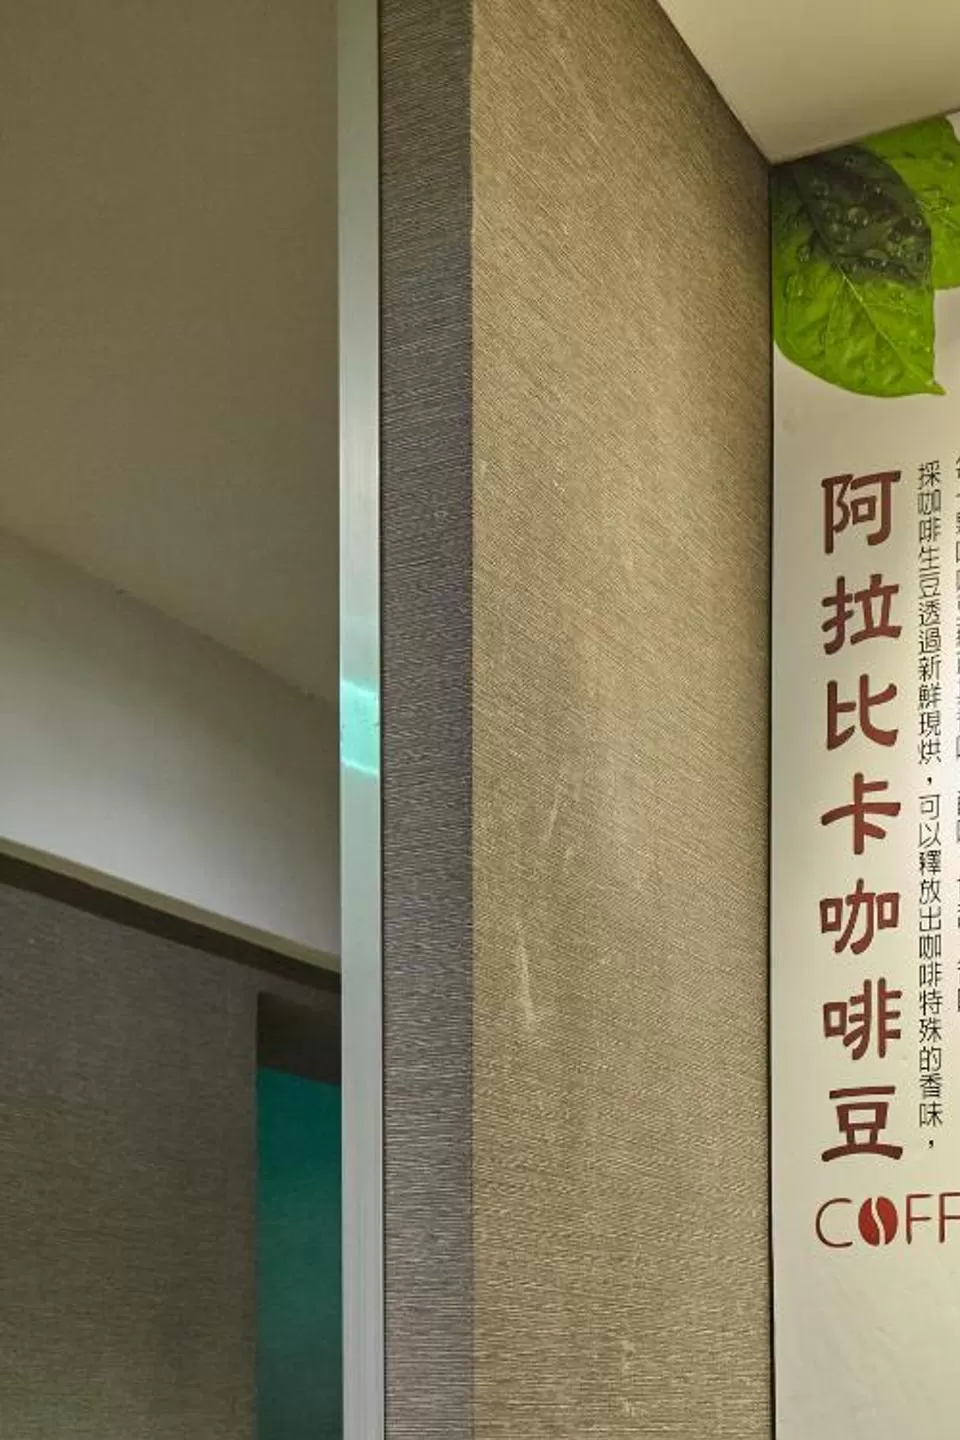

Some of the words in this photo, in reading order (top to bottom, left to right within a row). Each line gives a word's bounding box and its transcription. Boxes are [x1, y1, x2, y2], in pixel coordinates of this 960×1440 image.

[820, 470, 904, 1162] 阿拉比卡咖啡豆
